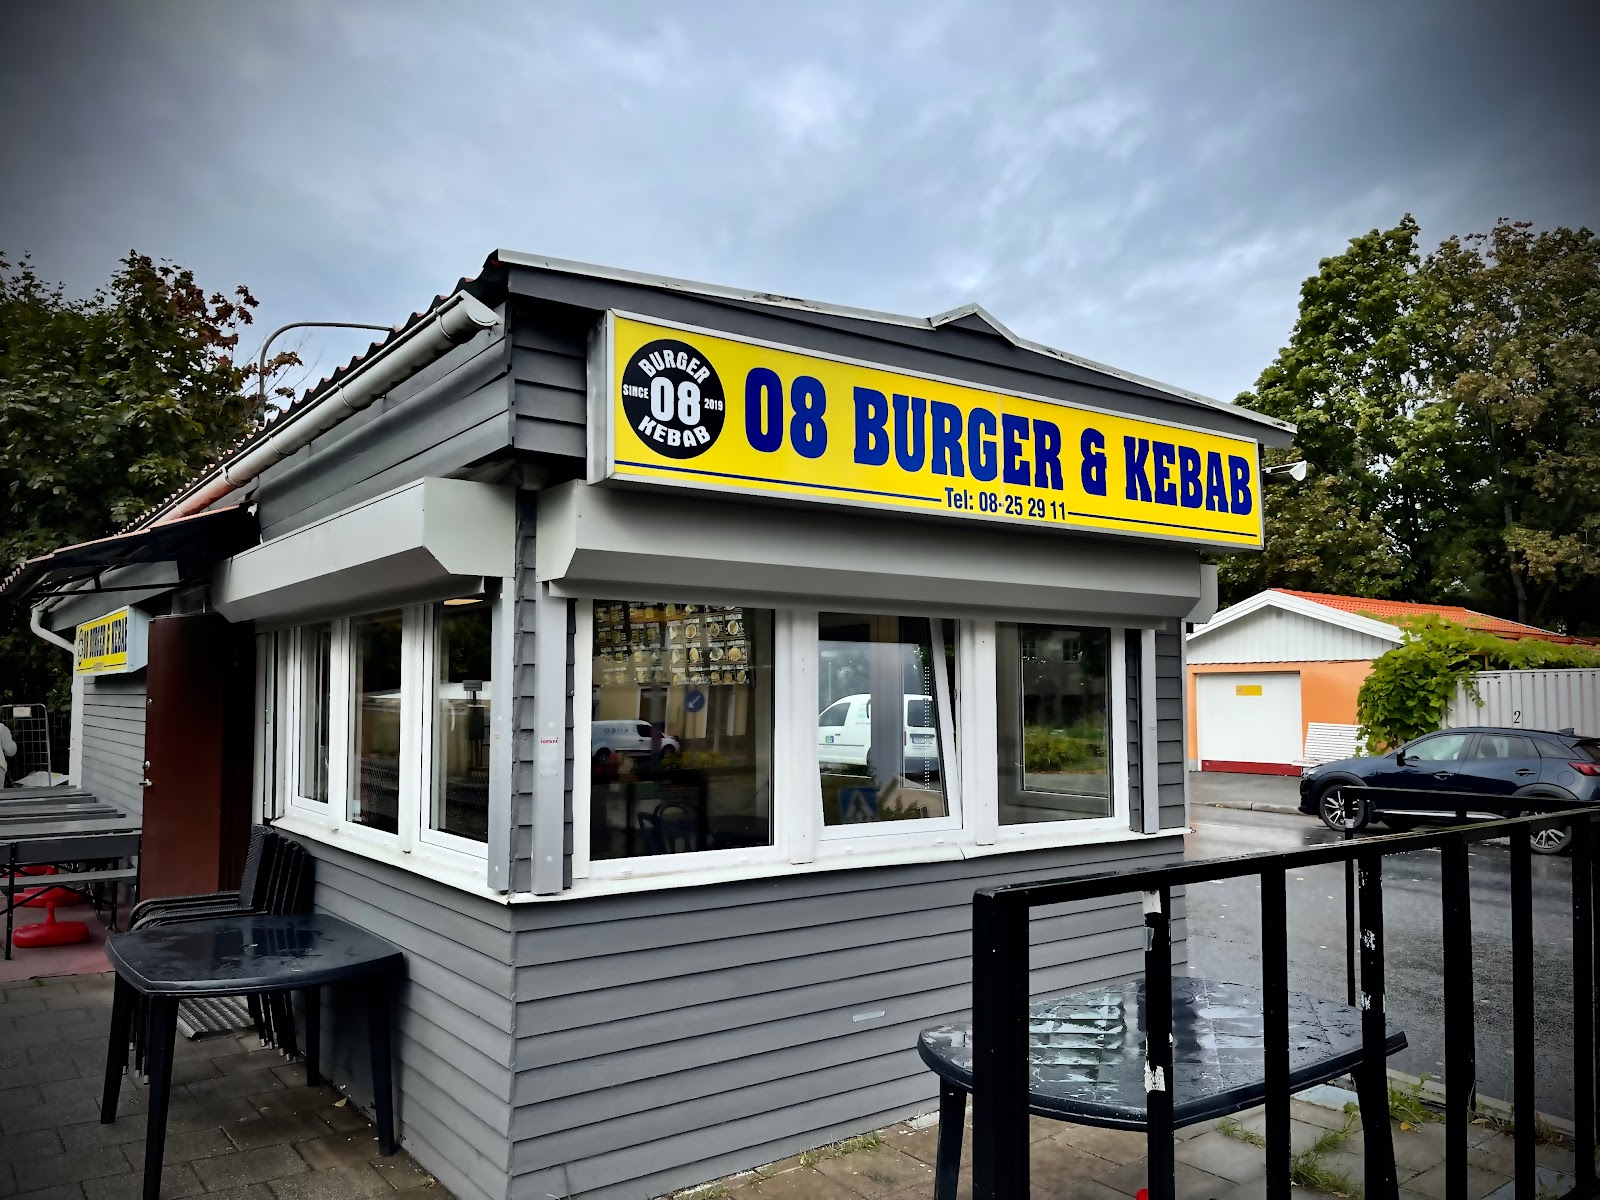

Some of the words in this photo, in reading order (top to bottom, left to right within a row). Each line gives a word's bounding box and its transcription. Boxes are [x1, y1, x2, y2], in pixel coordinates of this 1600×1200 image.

[638, 350, 710, 384] BURGER
[623, 384, 649, 399] SINCE
[651, 377, 701, 426] 08
[704, 398, 723, 412] 2019
[638, 415, 711, 447] KEBAB
[745, 367, 828, 459] 08
[854, 386, 1064, 490] BURGER
[1081, 428, 1107, 496] &
[1124, 436, 1253, 516] KEBAB
[945, 487, 973, 509] Tel:
[1028, 498, 1045, 518] 29
[1050, 501, 1065, 520] 11
[1513, 710, 1521, 724] 2
